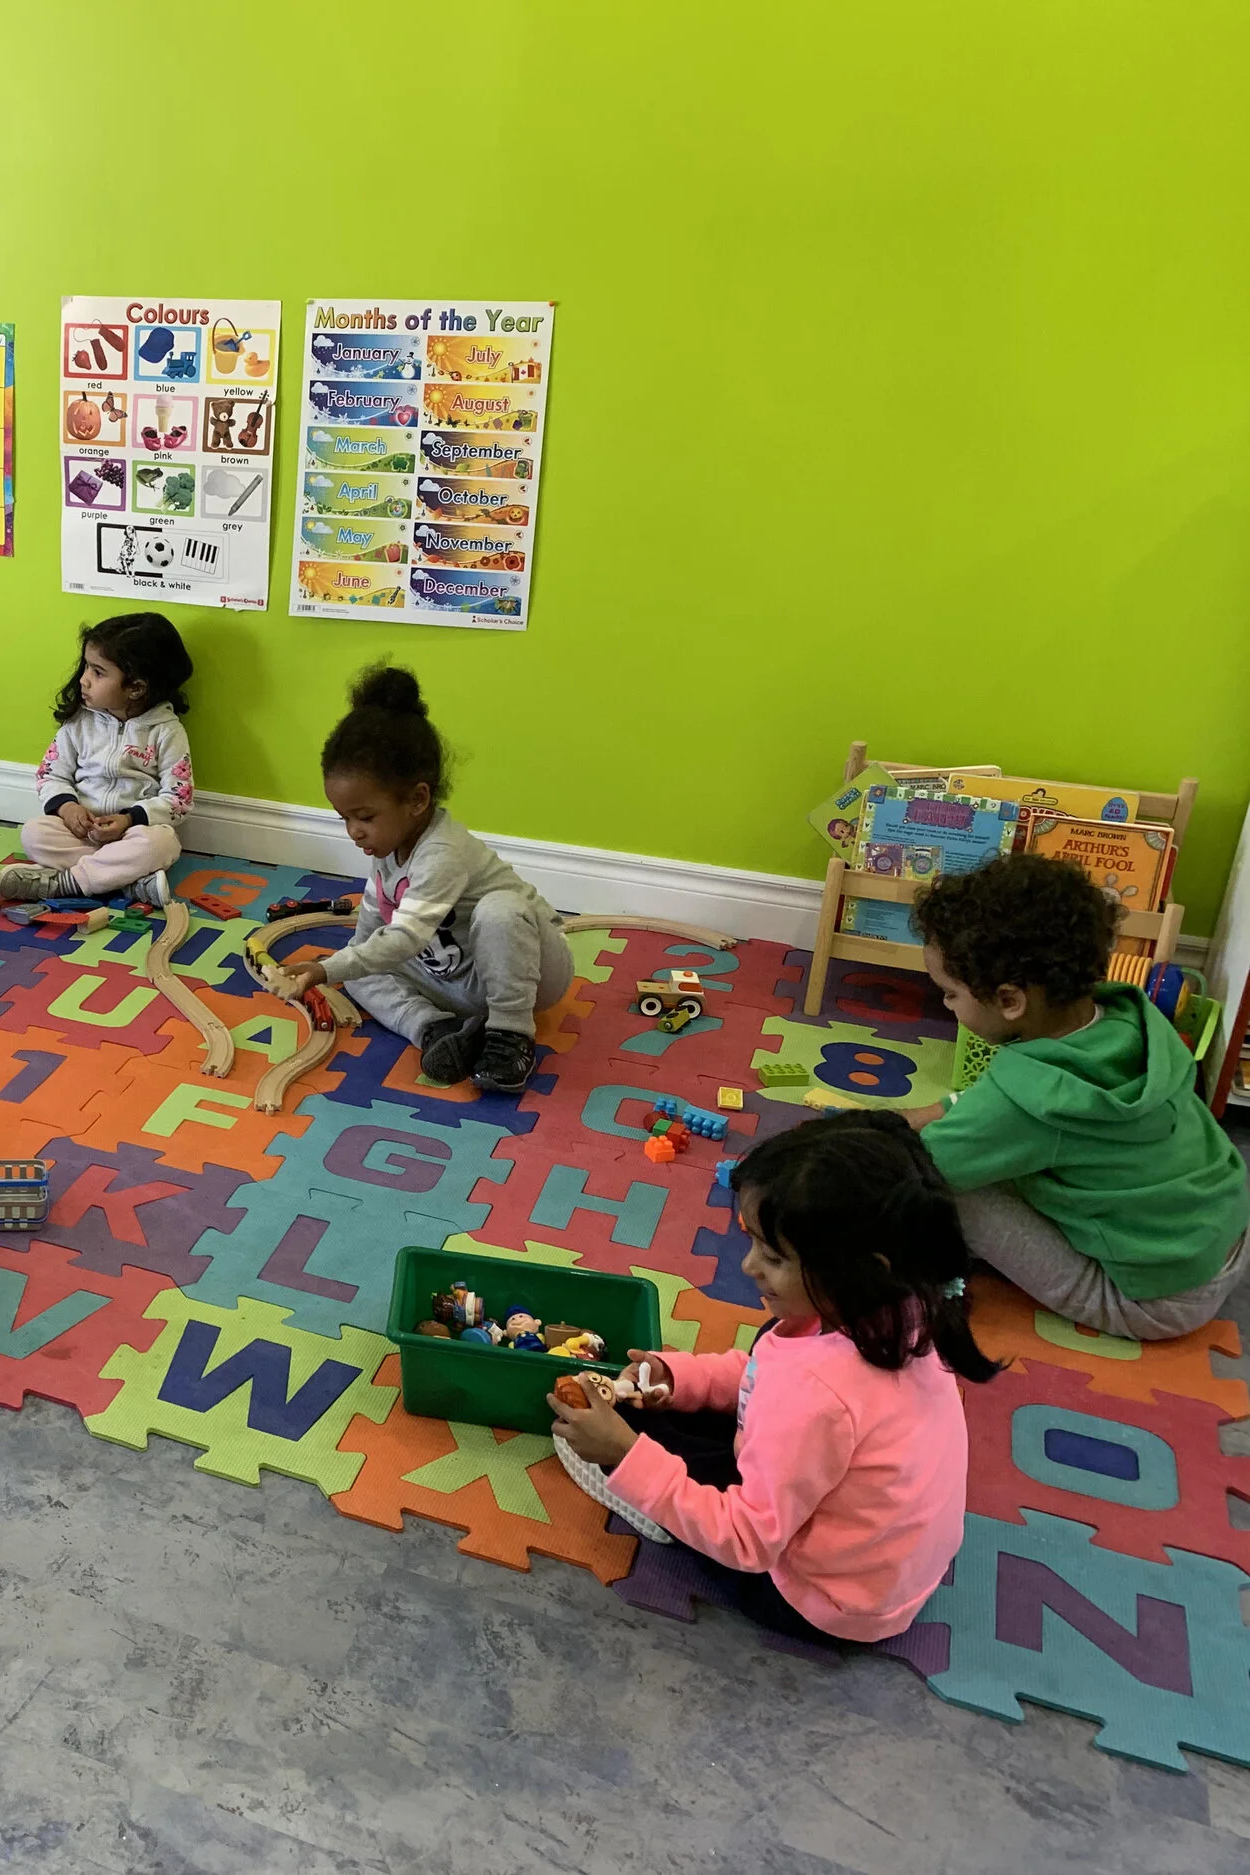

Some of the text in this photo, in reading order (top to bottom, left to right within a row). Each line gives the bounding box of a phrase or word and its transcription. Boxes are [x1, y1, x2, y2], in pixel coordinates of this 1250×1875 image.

[126, 302, 210, 325] Colours
[313, 307, 544, 333] Months of the Year
[332, 342, 402, 366] January
[465, 345, 503, 369] July
[87, 381, 103, 390] red
[155, 384, 176, 393] blue
[223, 386, 254, 397] yellow
[327, 389, 402, 414] February
[450, 394, 510, 415] August
[79, 447, 110, 456] orange
[153, 452, 173, 460] pink
[334, 437, 388, 455] March
[431, 441, 523, 461] September
[220, 455, 249, 465] brown
[336, 483, 378, 502] April
[438, 487, 508, 507] October
[81, 510, 108, 520] purple
[149, 517, 175, 526] green
[222, 522, 243, 532] grey
[336, 527, 375, 549] May
[425, 533, 513, 553] November
[133, 579, 157, 588] black
[168, 581, 192, 591] white
[332, 571, 371, 589] June
[423, 578, 509, 598] December
[503, 618, 524, 626] Choice
[122, 744, 153, 767] Tommy
[1070, 828, 1127, 841] MARC BROWN
[1062, 839, 1130, 857] ARTHUR'S
[1094, 857, 1136, 872] FOOL
[651, 944, 740, 993] 2
[46, 974, 160, 1028] U
[197, 1014, 298, 1064] A
[813, 1041, 918, 1098] 8
[140, 1082, 254, 1138] F
[323, 1124, 452, 1193] G
[50, 1163, 195, 1248] K
[529, 1164, 670, 1249] H
[257, 1214, 359, 1303] L
[156, 1319, 363, 1442] W
[400, 1420, 557, 1525] X
[996, 1551, 1194, 1698] N
